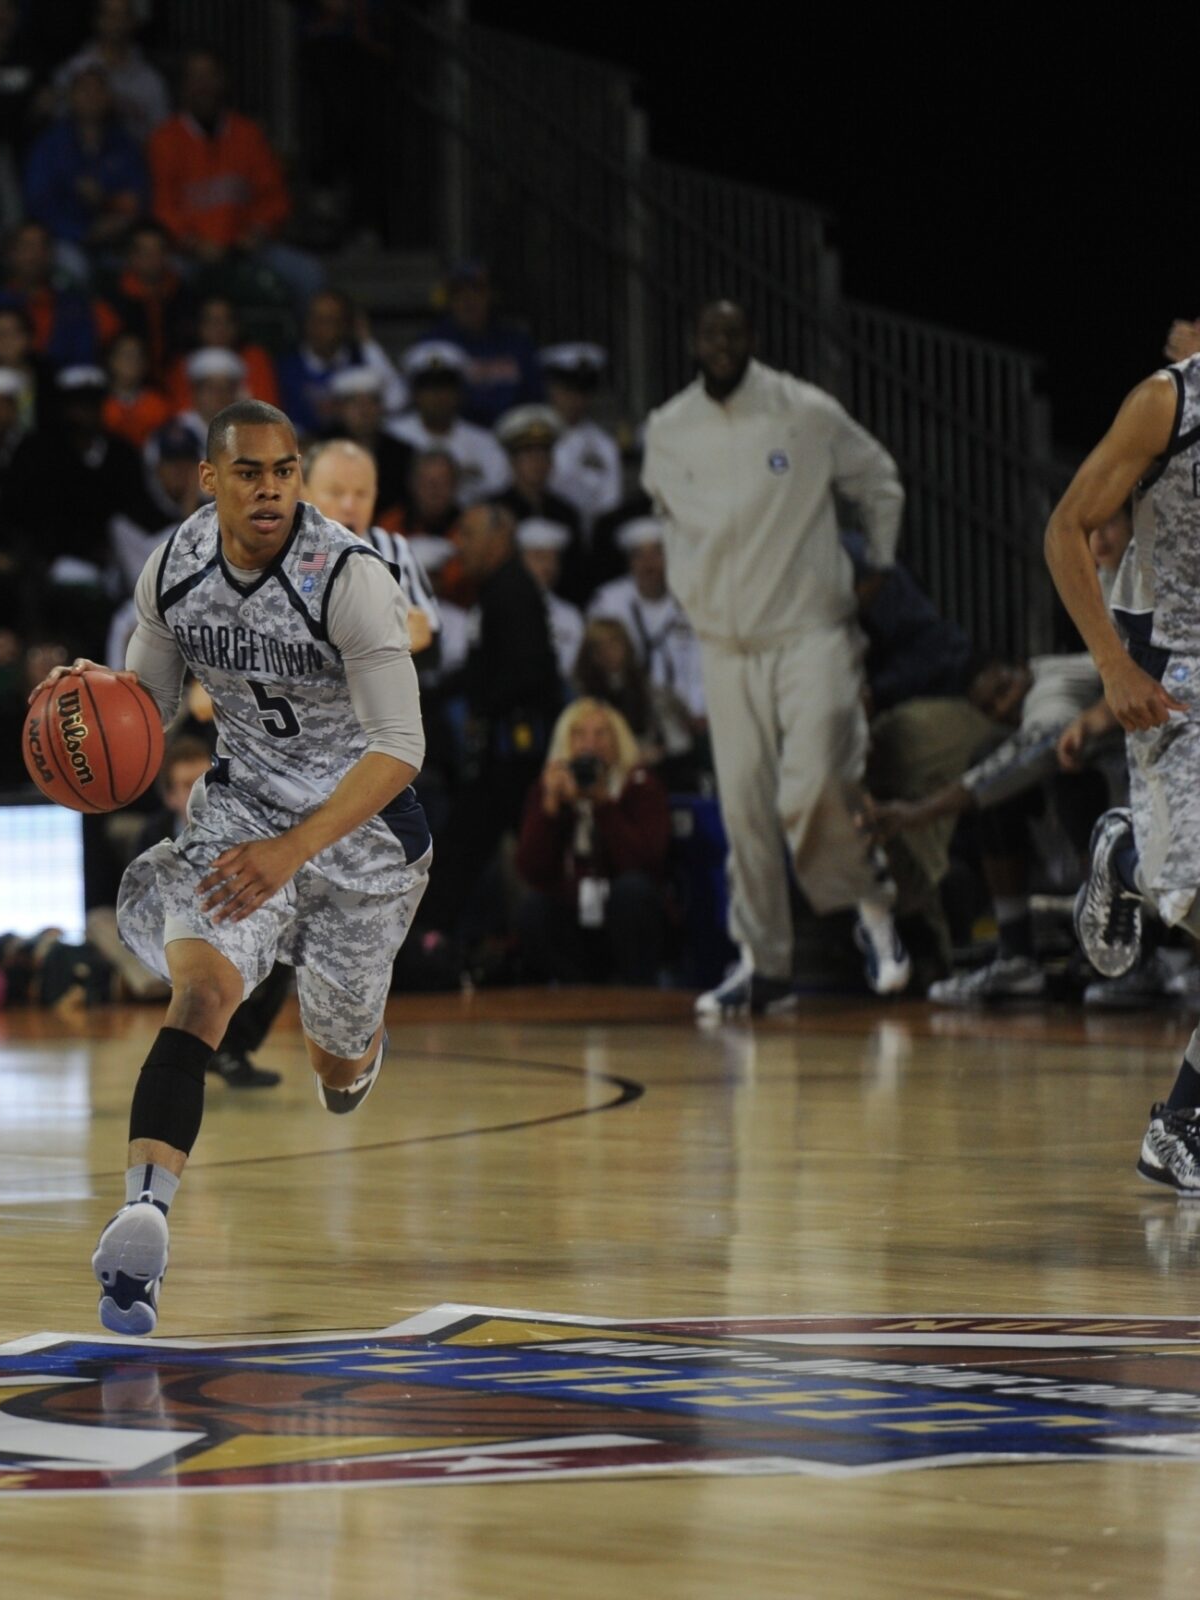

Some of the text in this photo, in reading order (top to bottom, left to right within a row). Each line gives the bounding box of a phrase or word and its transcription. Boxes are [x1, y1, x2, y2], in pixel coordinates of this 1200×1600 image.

[173, 624, 323, 677] GEORGETOWN
[56, 688, 96, 788] Wilson
[246, 679, 301, 738] 5
[29, 718, 55, 784] NCAA
[225, 1348, 1115, 1434] CLASSIC
